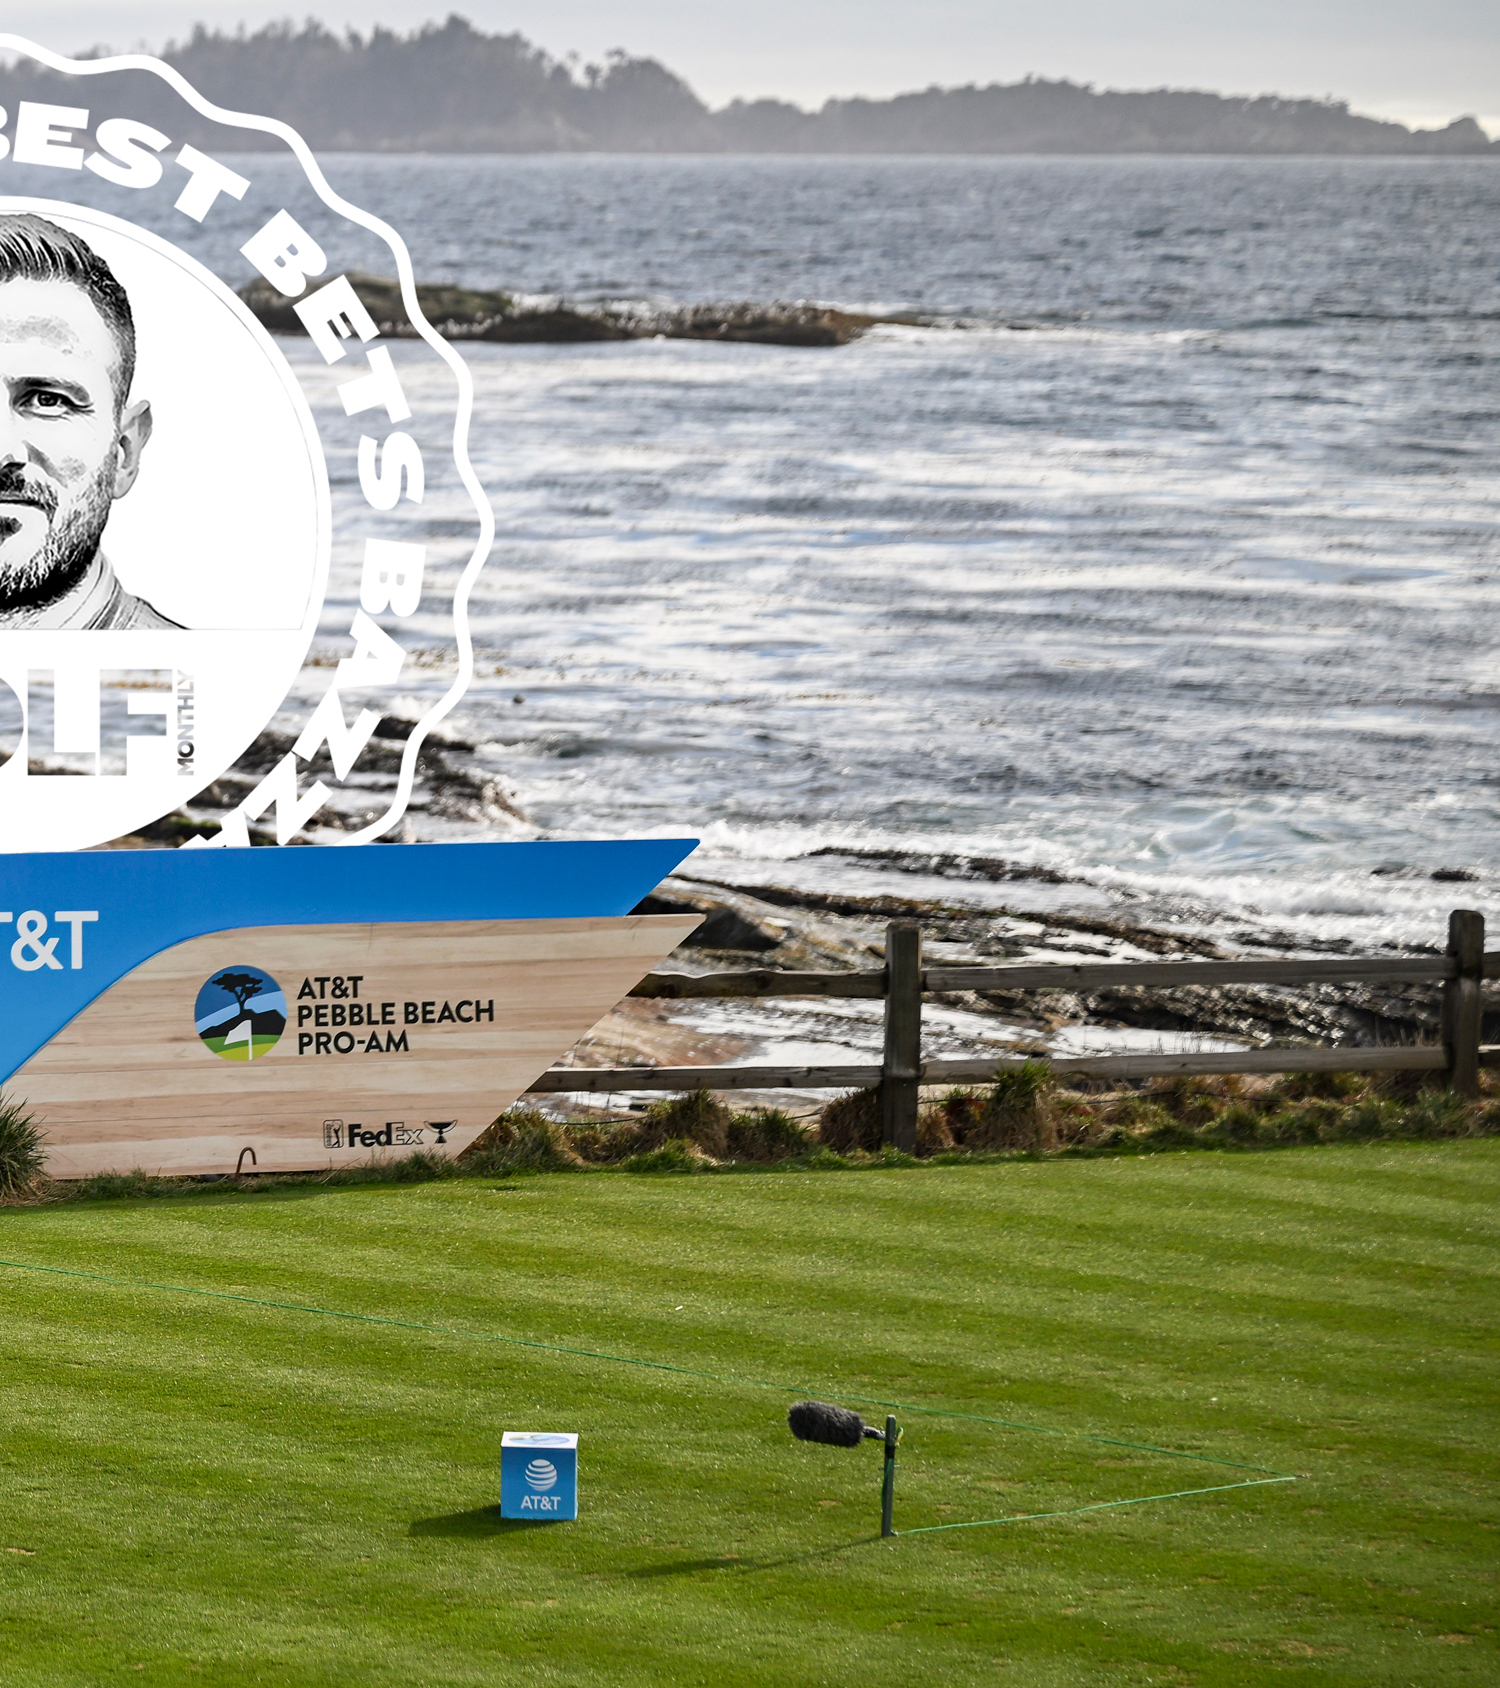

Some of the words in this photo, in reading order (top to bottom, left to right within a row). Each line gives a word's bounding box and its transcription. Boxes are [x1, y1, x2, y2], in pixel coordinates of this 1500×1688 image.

[297, 975, 363, 1000] AT&T
[297, 1002, 396, 1028] PEBBLE
[403, 999, 495, 1025] BEACH
[298, 1030, 410, 1056] PRO-AM
[348, 1121, 424, 1148] FedEx
[520, 1495, 561, 1511] AT&T
